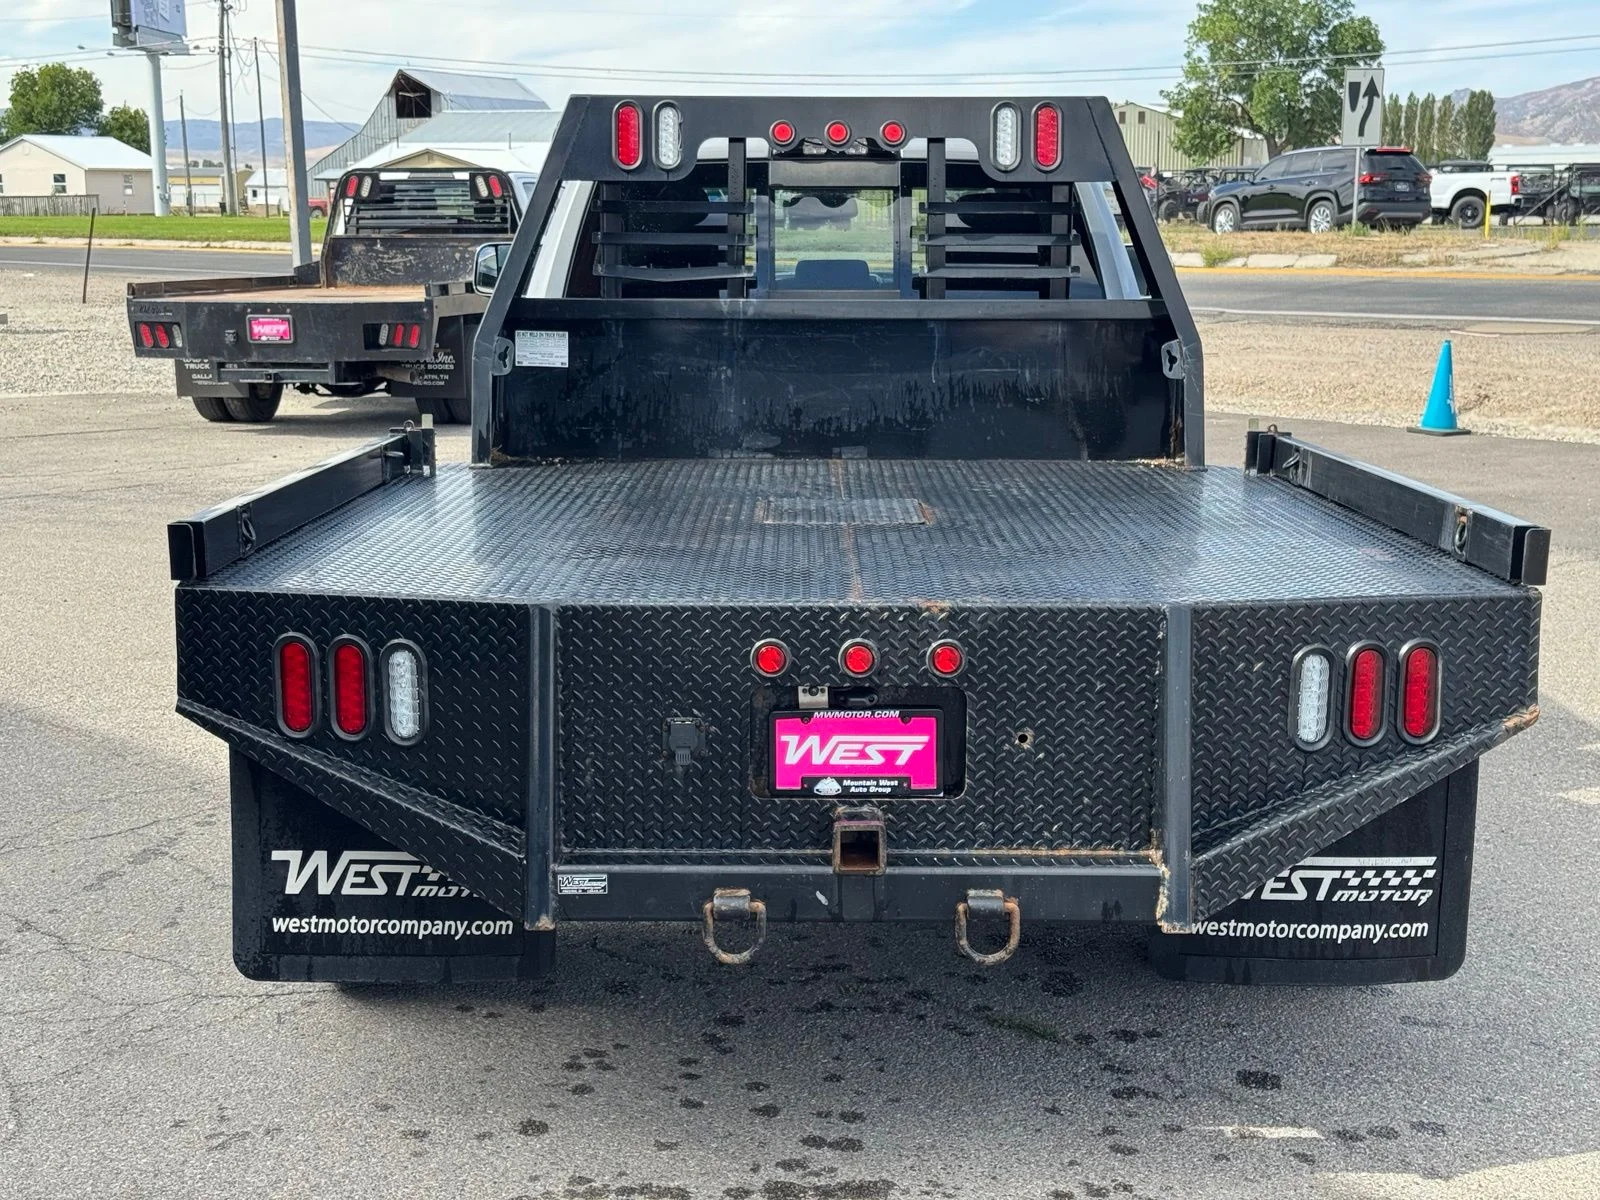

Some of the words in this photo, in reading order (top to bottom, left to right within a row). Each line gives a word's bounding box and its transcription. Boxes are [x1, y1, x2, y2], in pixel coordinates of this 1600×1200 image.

[813, 710, 900, 719] MWMOTOR.COM
[780, 735, 930, 766] WEST
[843, 779, 877, 787] Mountain
[879, 779, 899, 787] West
[869, 786, 892, 794] Group
[271, 850, 421, 896] WEST
[411, 885, 480, 898] MOT
[1332, 889, 1433, 907] MOTOR
[271, 914, 514, 940] westmotorcompany.com
[1191, 919, 1429, 944] westmotorcompany.com
